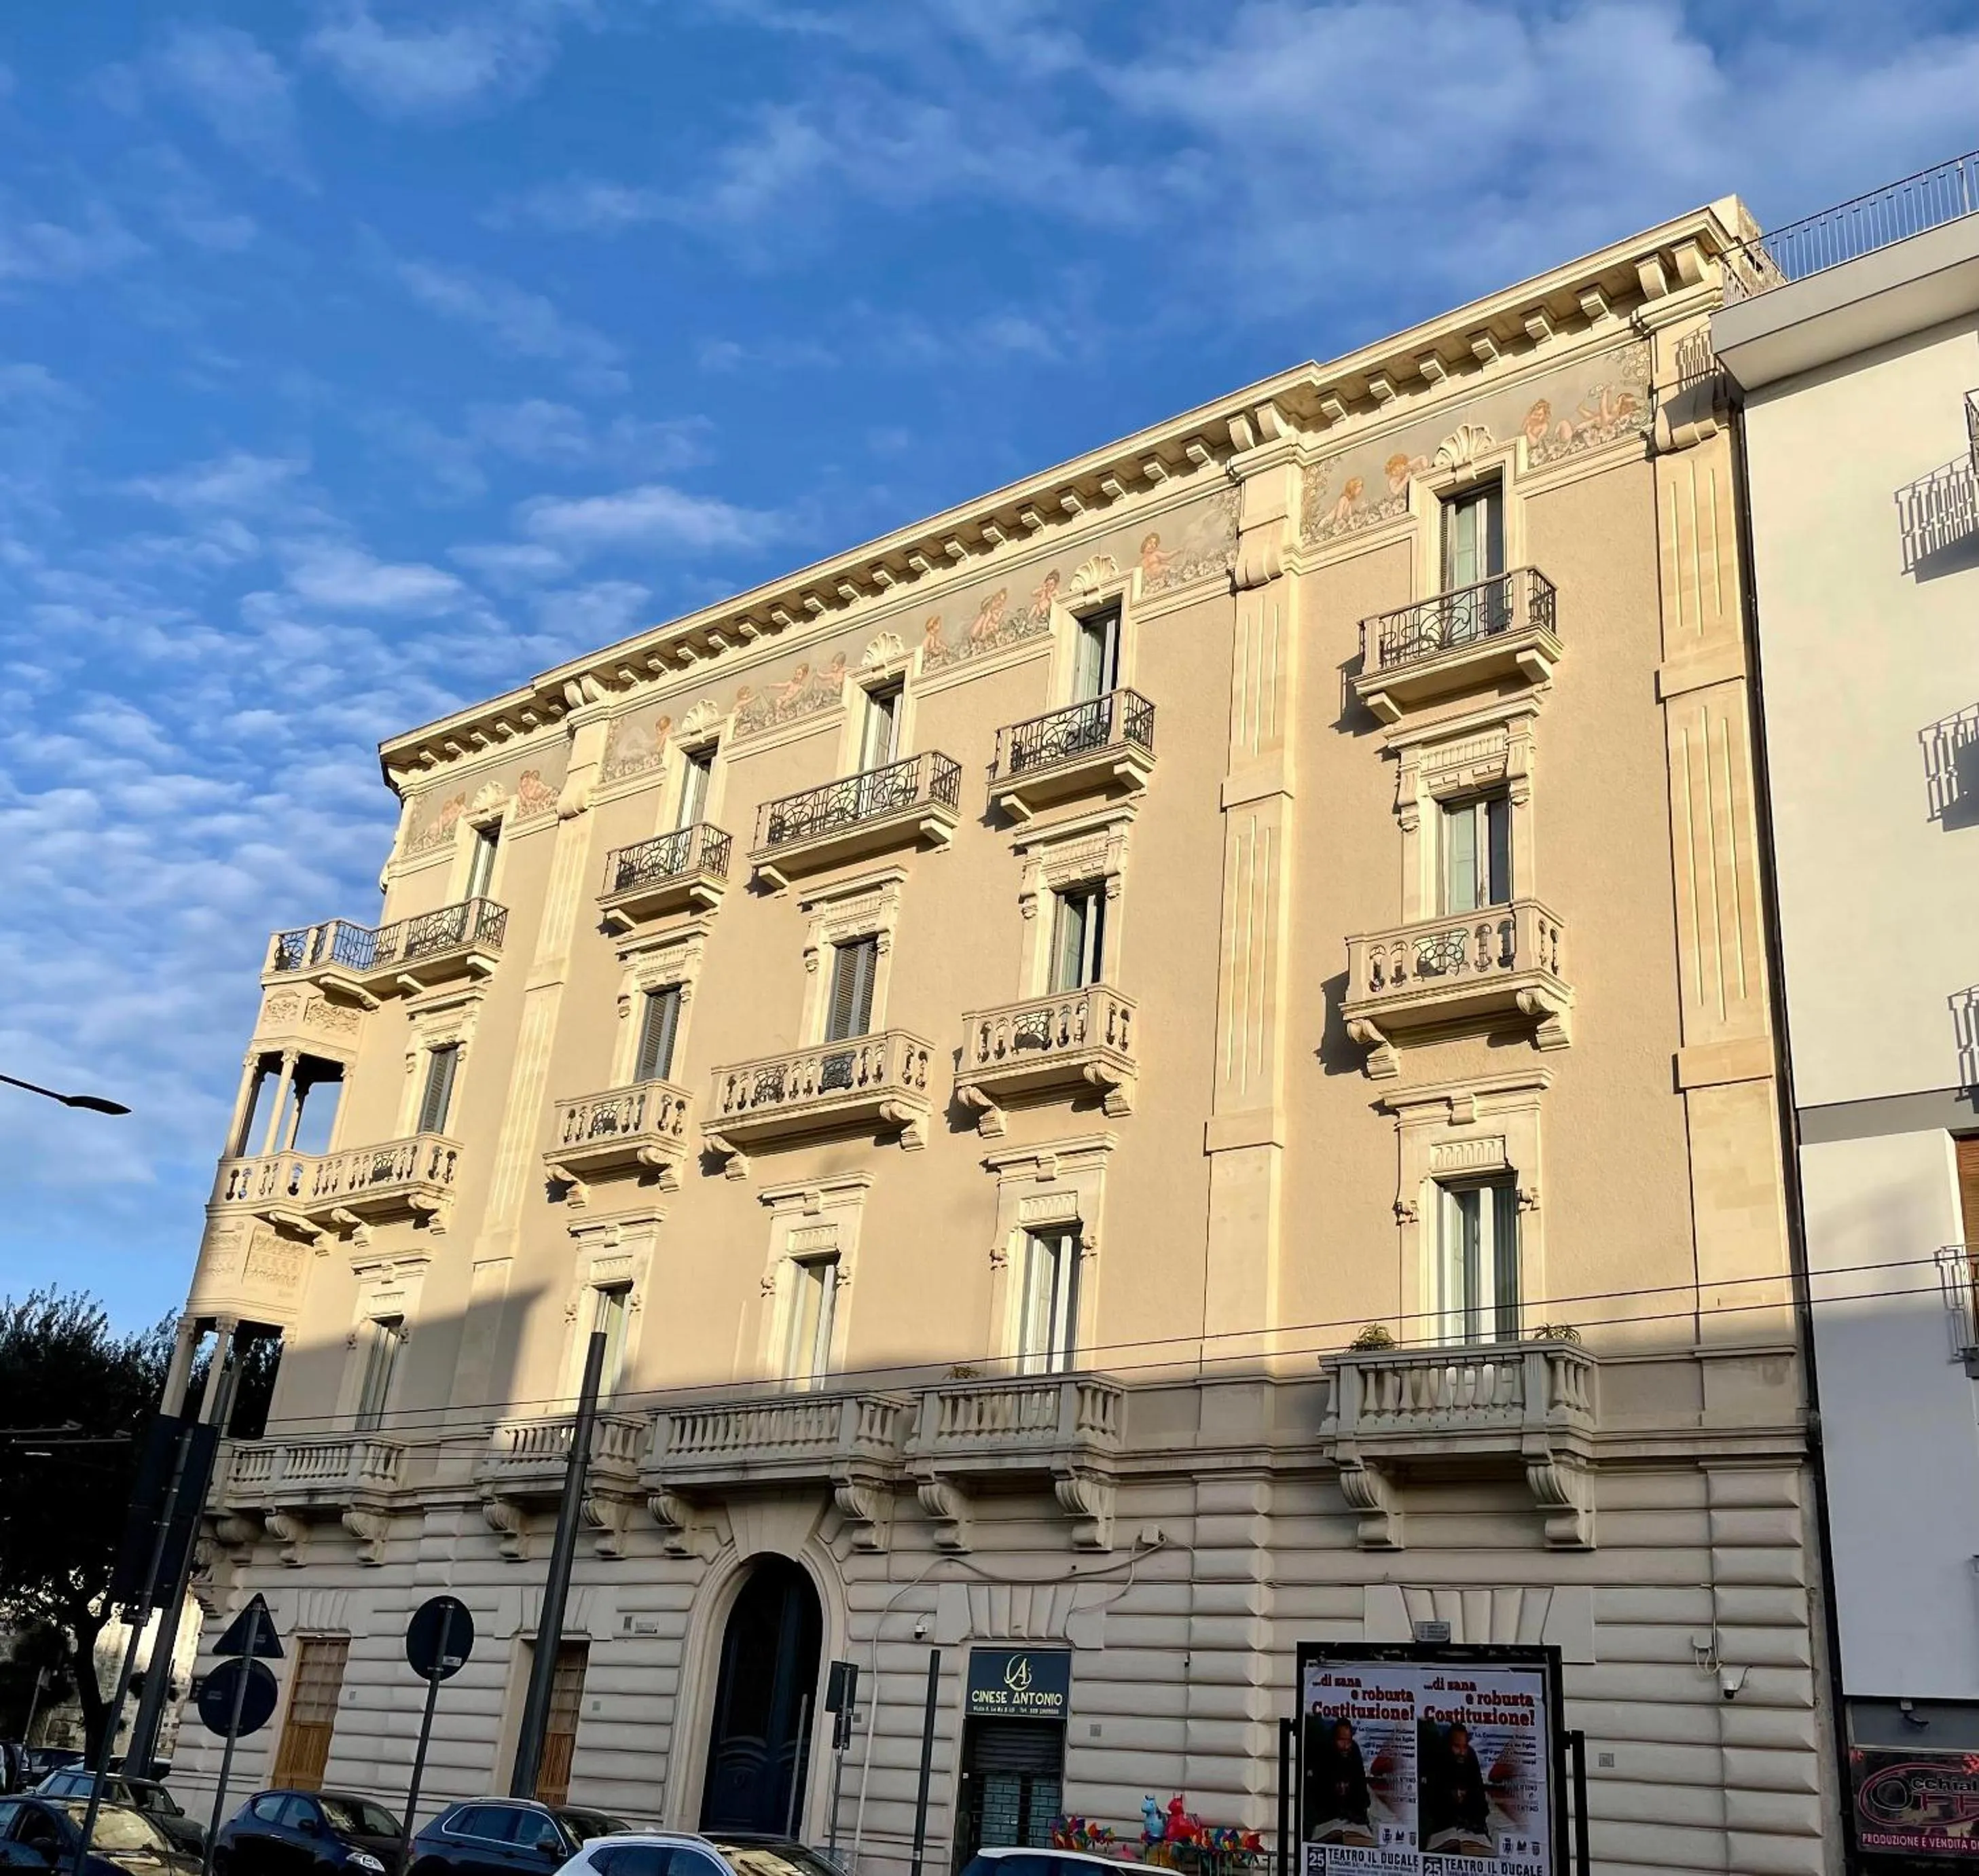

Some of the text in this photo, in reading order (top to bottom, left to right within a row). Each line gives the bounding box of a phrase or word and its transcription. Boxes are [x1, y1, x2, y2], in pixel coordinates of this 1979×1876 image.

[972, 1690, 1063, 1706] CINESE ANTONIO
[1351, 1686, 1415, 1702] e robusta
[1466, 1690, 1534, 1707] e robusta
[1312, 1701, 1415, 1721] Costituzione!
[1424, 1706, 1535, 1726] Costituzione!
[1862, 1833, 1919, 1847] PRODUZIONE
[1922, 1836, 1927, 1847] E
[1929, 1837, 1967, 1850] VENDITA
[1309, 1852, 1325, 1868] 25
[1328, 1848, 1364, 1862] TEATRO
[1368, 1851, 1376, 1864] IL
[1381, 1853, 1419, 1866] DUCALE
[1424, 1862, 1441, 1876] 25
[1445, 1858, 1542, 1876] TEATRO IL DUCALE
